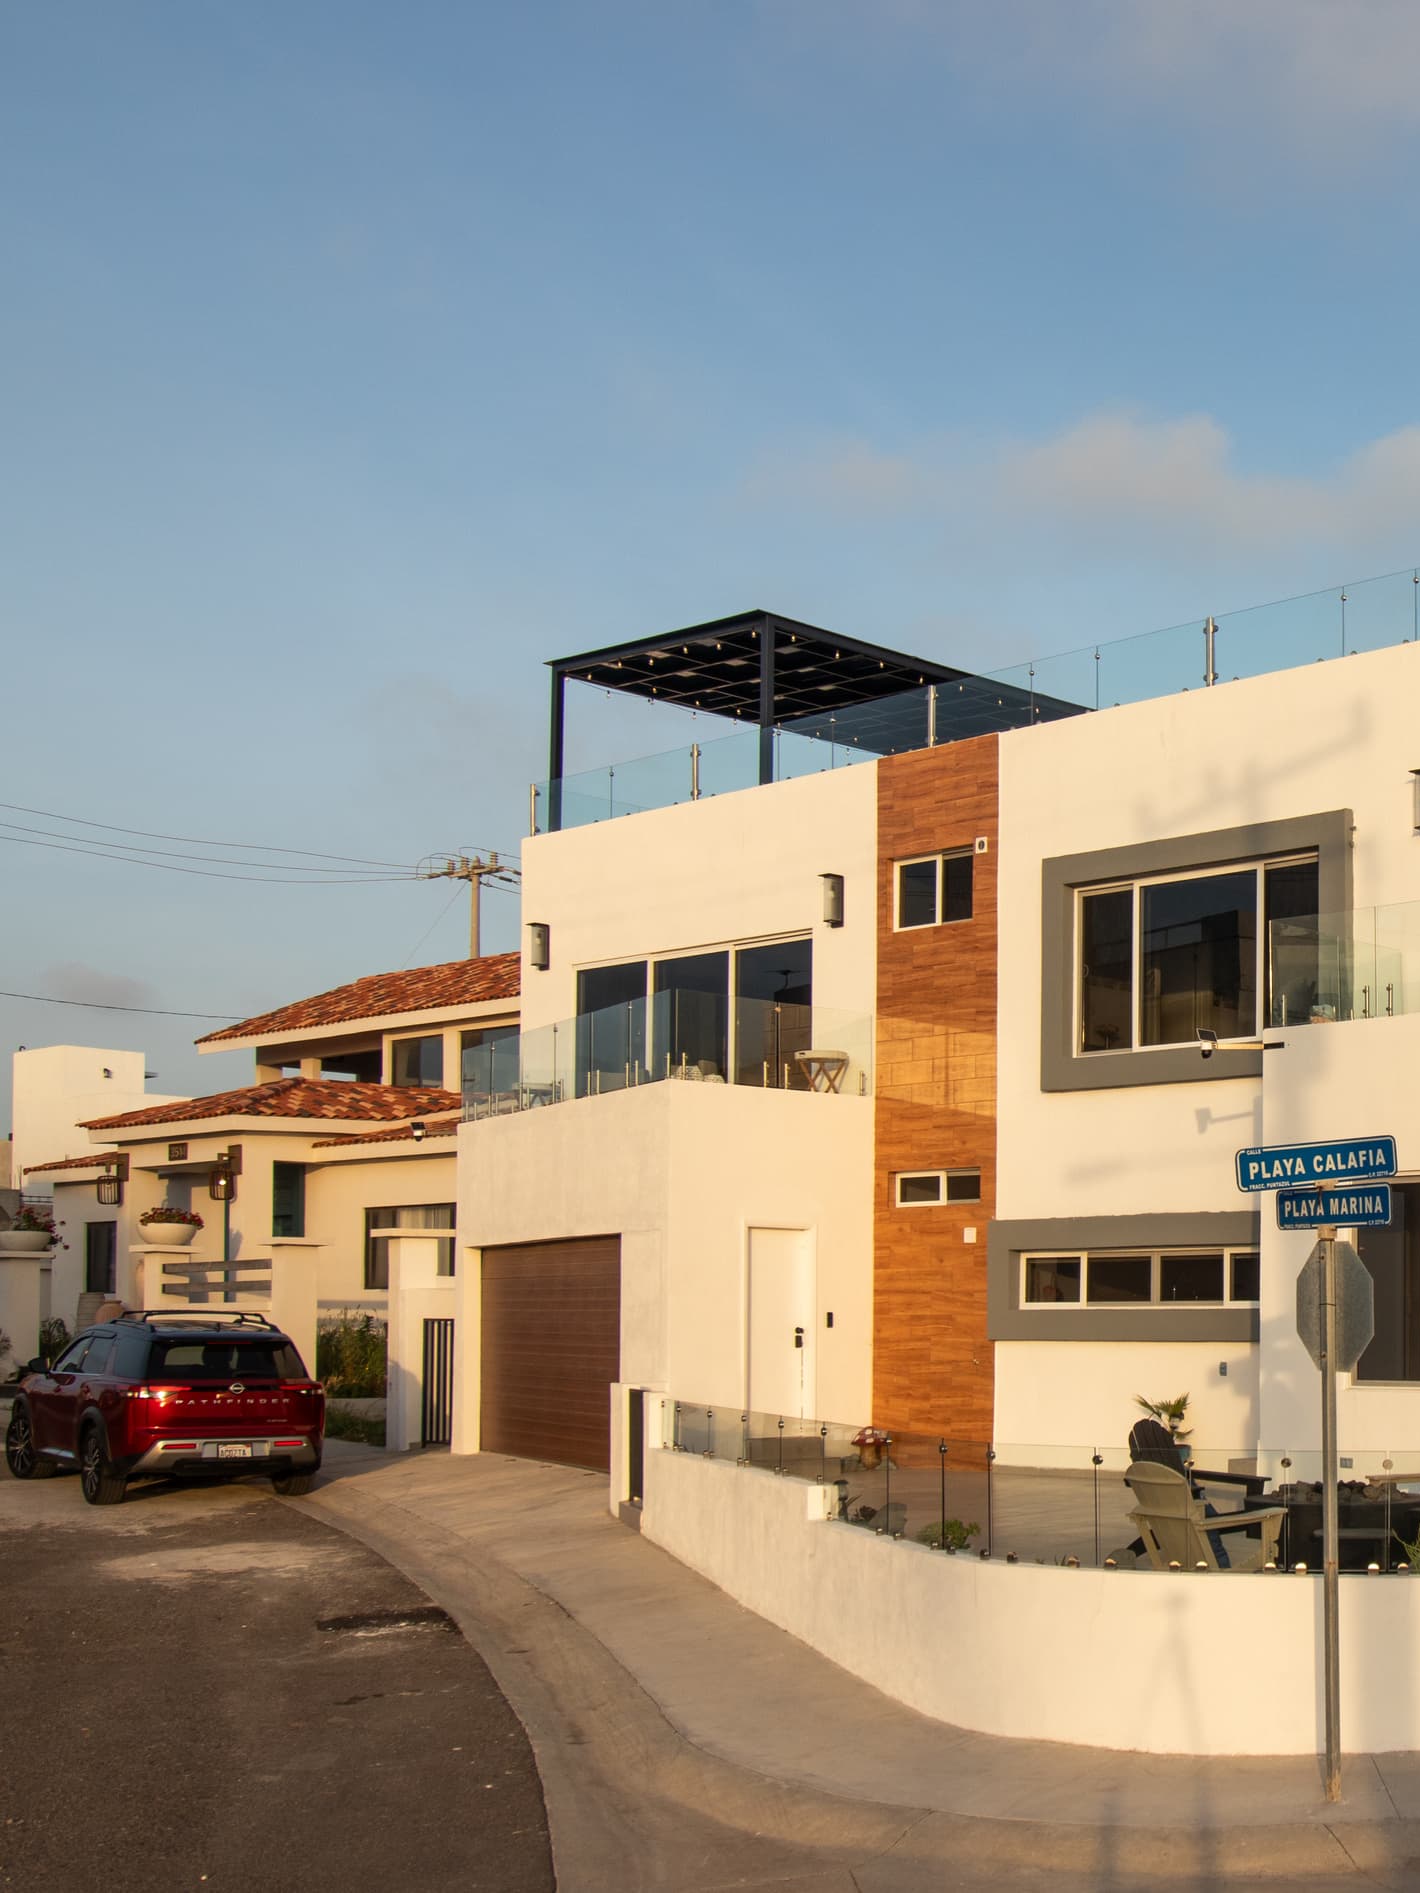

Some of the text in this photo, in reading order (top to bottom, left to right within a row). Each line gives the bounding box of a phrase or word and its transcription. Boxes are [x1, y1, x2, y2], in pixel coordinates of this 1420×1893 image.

[1249, 1148, 1387, 1180] PLAYA CALAFIA
[1284, 1195, 1384, 1218] PLAYA MARINA
